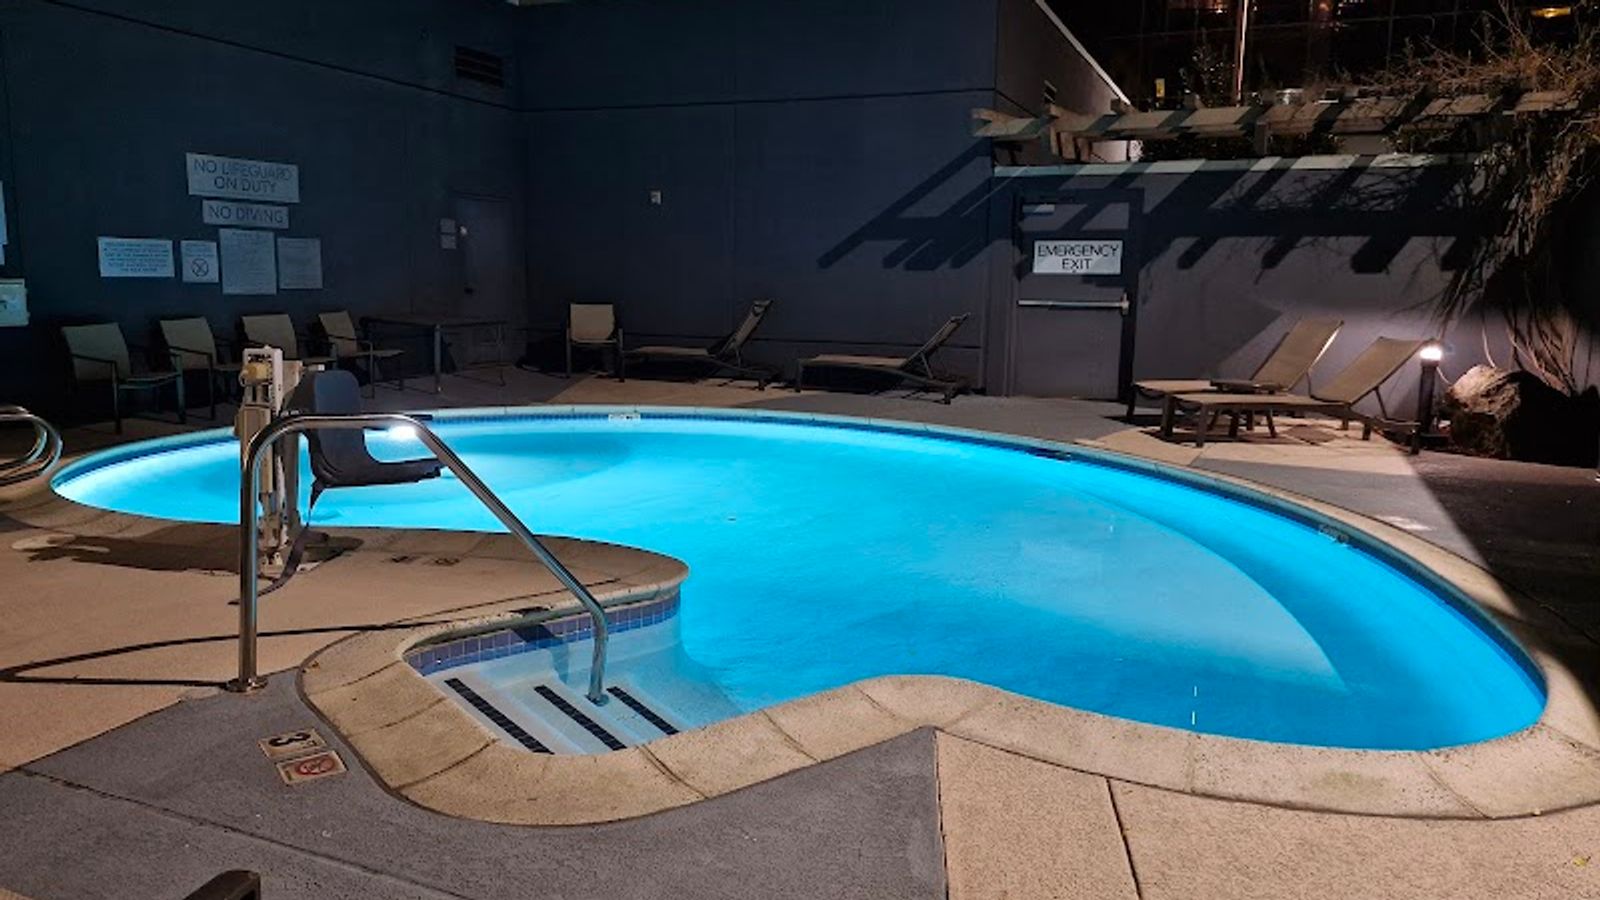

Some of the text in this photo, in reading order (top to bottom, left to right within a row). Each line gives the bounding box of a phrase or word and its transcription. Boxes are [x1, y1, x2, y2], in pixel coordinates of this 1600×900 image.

[194, 159, 293, 181] NO LIFEGUARD
[214, 176, 277, 193] ON DUTY
[208, 205, 284, 223] NO DIVING
[1037, 244, 1119, 257] EMERGENCY
[1062, 258, 1092, 269] EXIT
